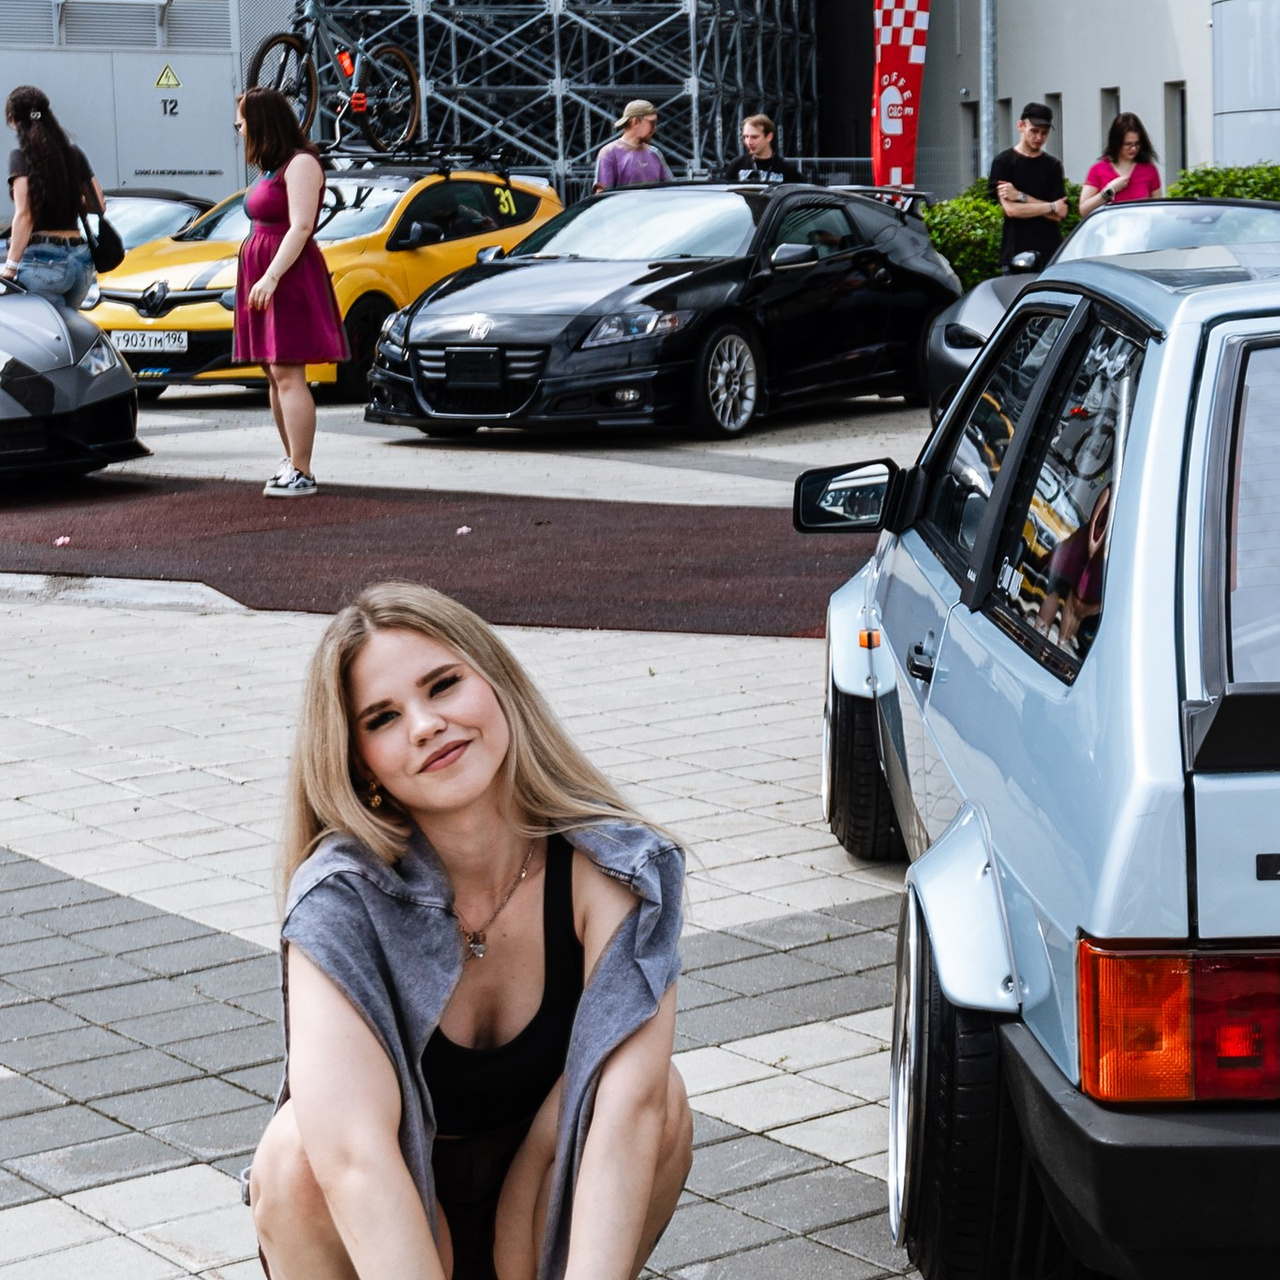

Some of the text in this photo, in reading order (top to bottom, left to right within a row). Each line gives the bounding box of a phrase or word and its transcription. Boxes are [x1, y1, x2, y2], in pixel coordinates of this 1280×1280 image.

[160, 99, 179, 116] T2
[494, 187, 517, 216] 31
[165, 332, 184, 345] 196
